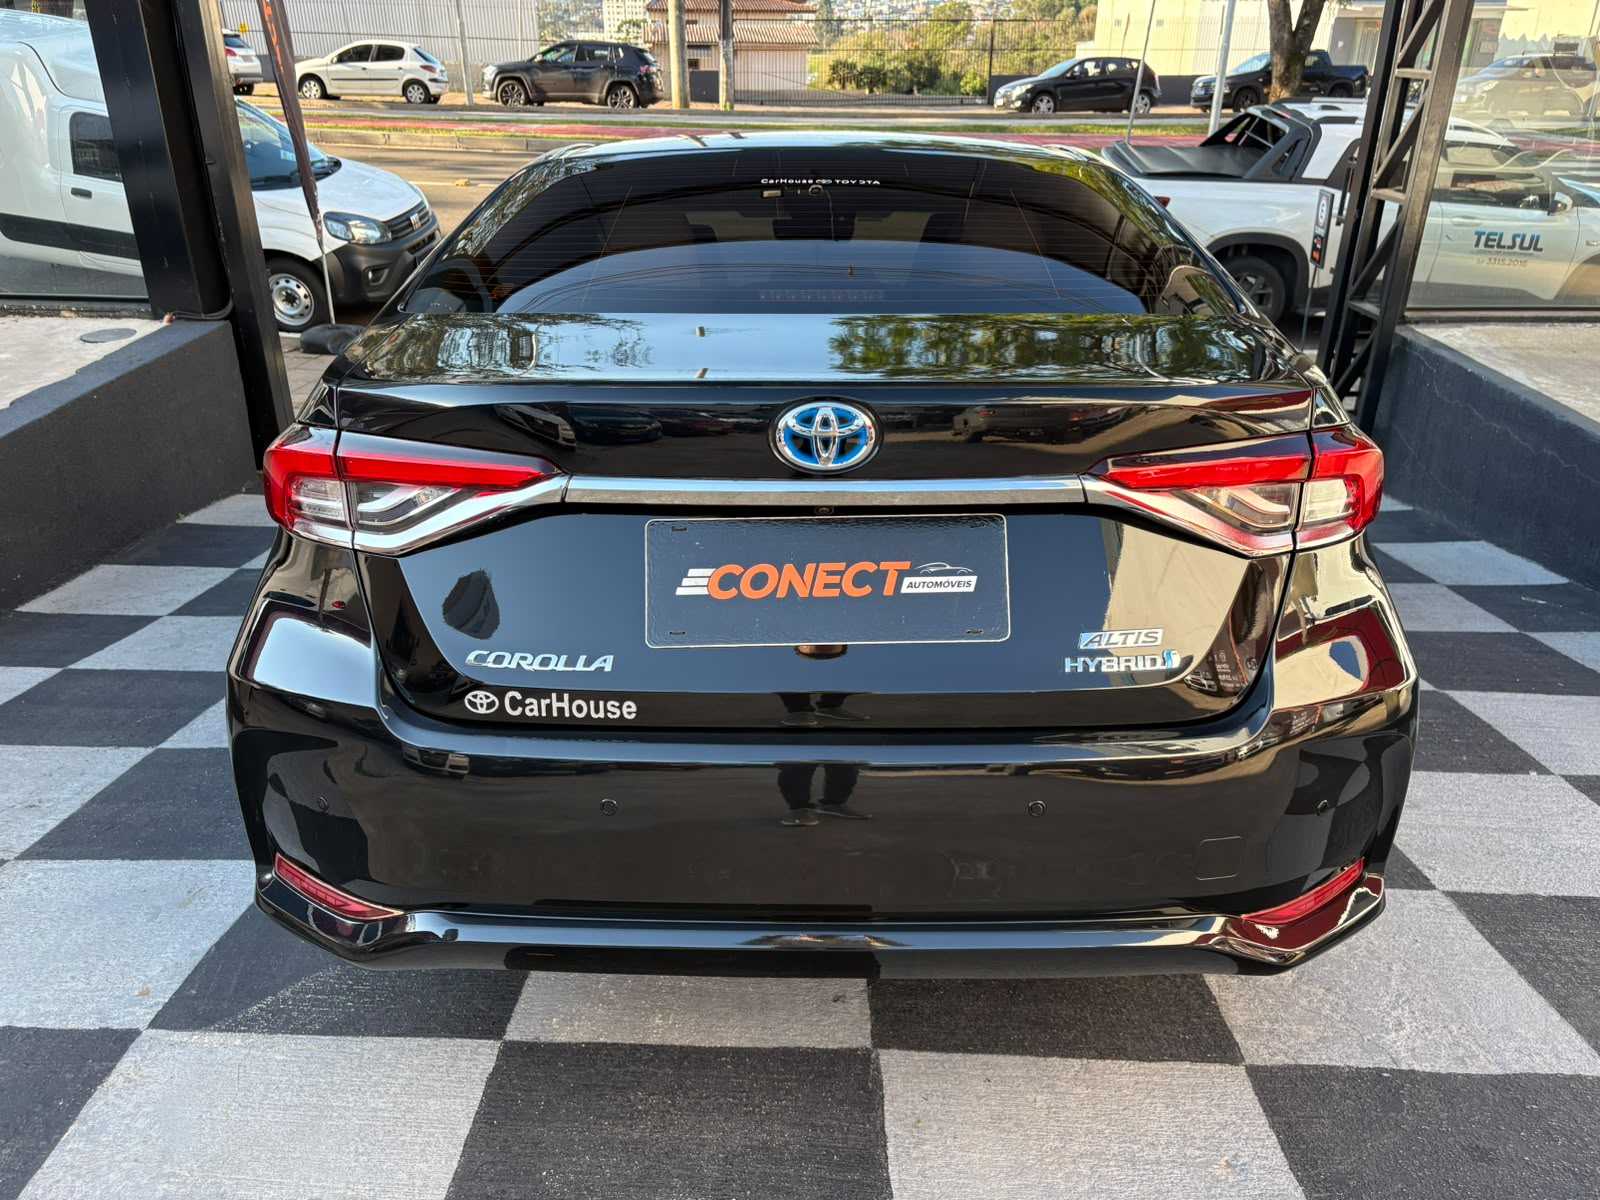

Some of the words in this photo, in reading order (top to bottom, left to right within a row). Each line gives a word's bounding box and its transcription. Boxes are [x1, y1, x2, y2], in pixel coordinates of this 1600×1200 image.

[1473, 230, 1544, 253] TELSUL
[707, 561, 912, 600] CONECT
[905, 578, 973, 590] AUTOMÓVEIS
[1083, 630, 1160, 647] ALTIS
[465, 649, 616, 673] COROLLA
[1064, 655, 1164, 674] HYBRID
[504, 691, 638, 720] CarHouse
